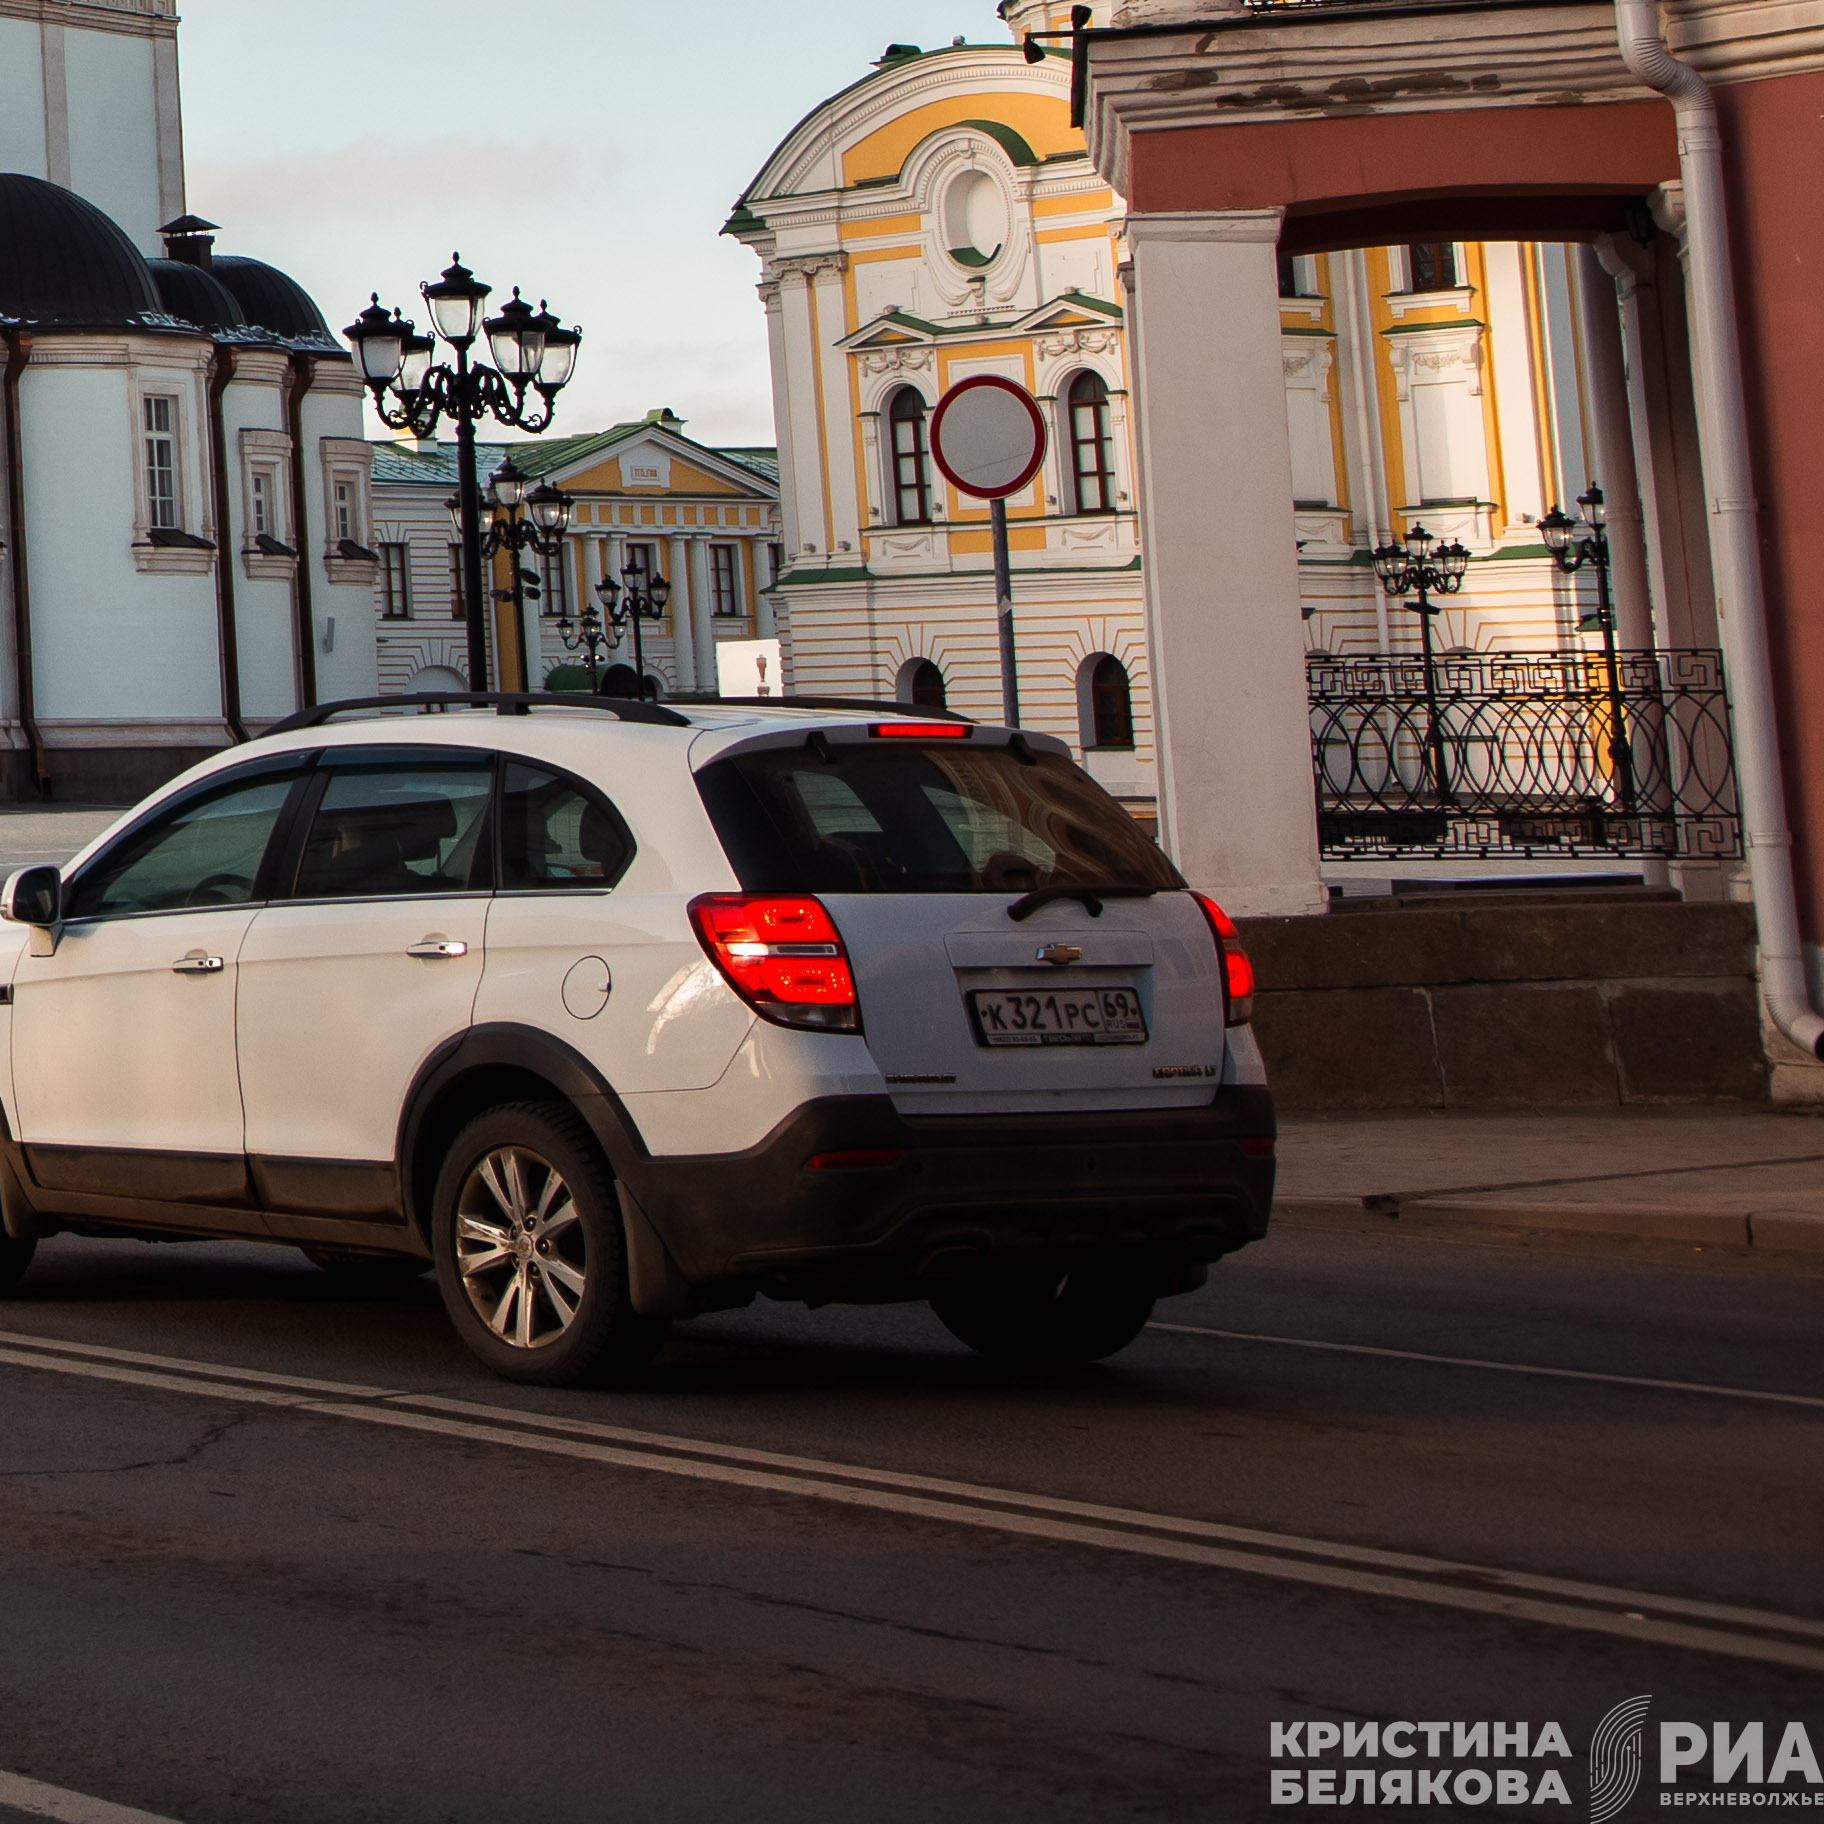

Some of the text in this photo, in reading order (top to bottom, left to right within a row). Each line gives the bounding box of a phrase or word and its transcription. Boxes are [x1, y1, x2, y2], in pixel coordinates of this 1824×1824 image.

[987, 993, 1129, 1031] К321РС 69
[1107, 1018, 1127, 1030] RUS
